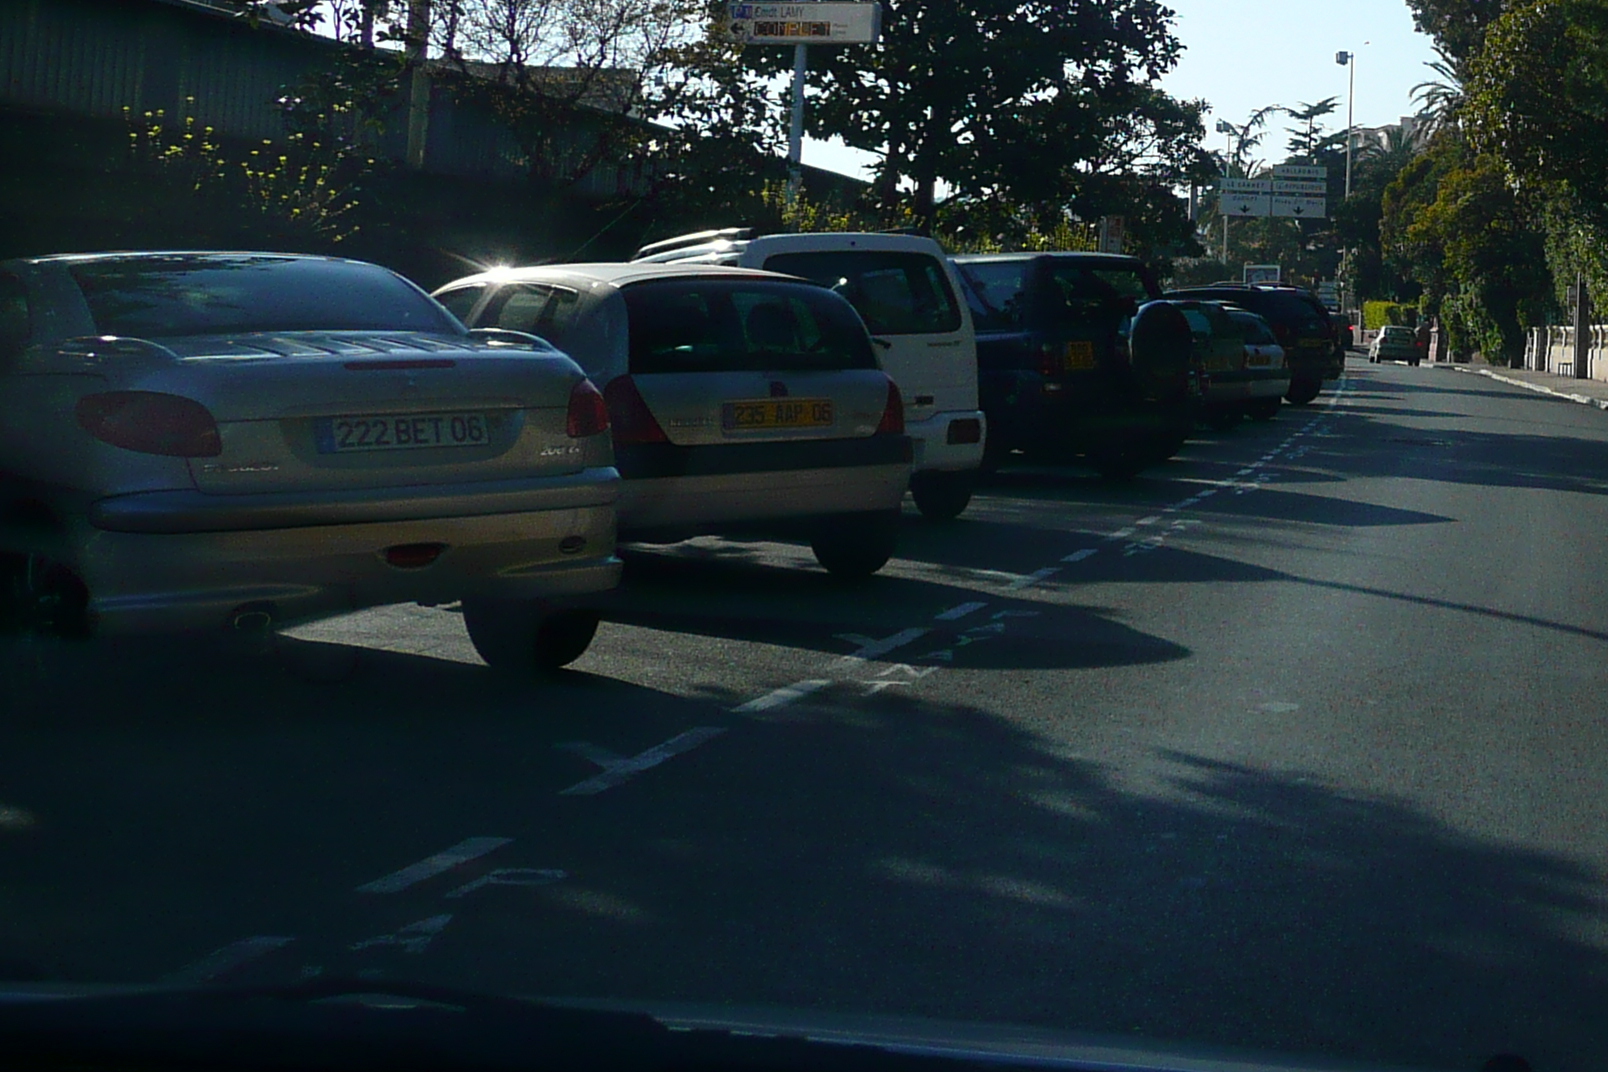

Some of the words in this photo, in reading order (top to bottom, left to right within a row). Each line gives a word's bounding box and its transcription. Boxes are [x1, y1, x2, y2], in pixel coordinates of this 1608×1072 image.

[780, 6, 805, 18] LAMY
[337, 419, 391, 448] 222
[395, 417, 444, 445] BET
[451, 416, 482, 443] 06
